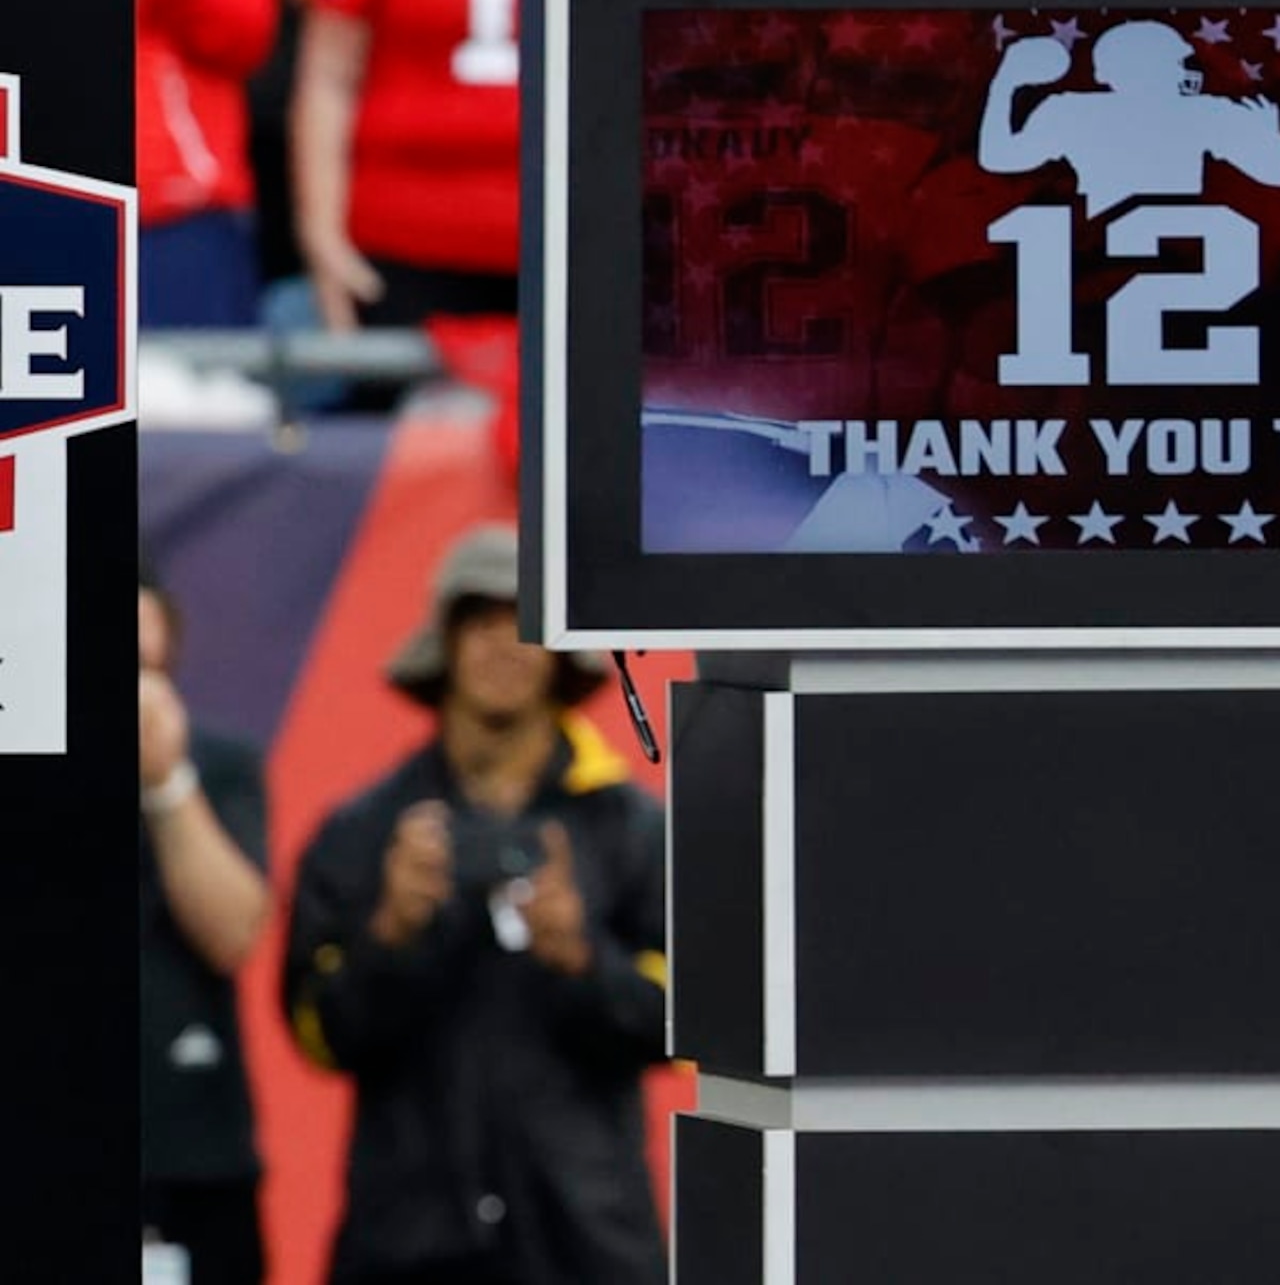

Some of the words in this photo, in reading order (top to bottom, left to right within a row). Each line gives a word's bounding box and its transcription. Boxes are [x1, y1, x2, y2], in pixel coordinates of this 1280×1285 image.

[986, 204, 1261, 386] 12
[800, 418, 1067, 477] THANK
[1090, 418, 1252, 475] YOU
